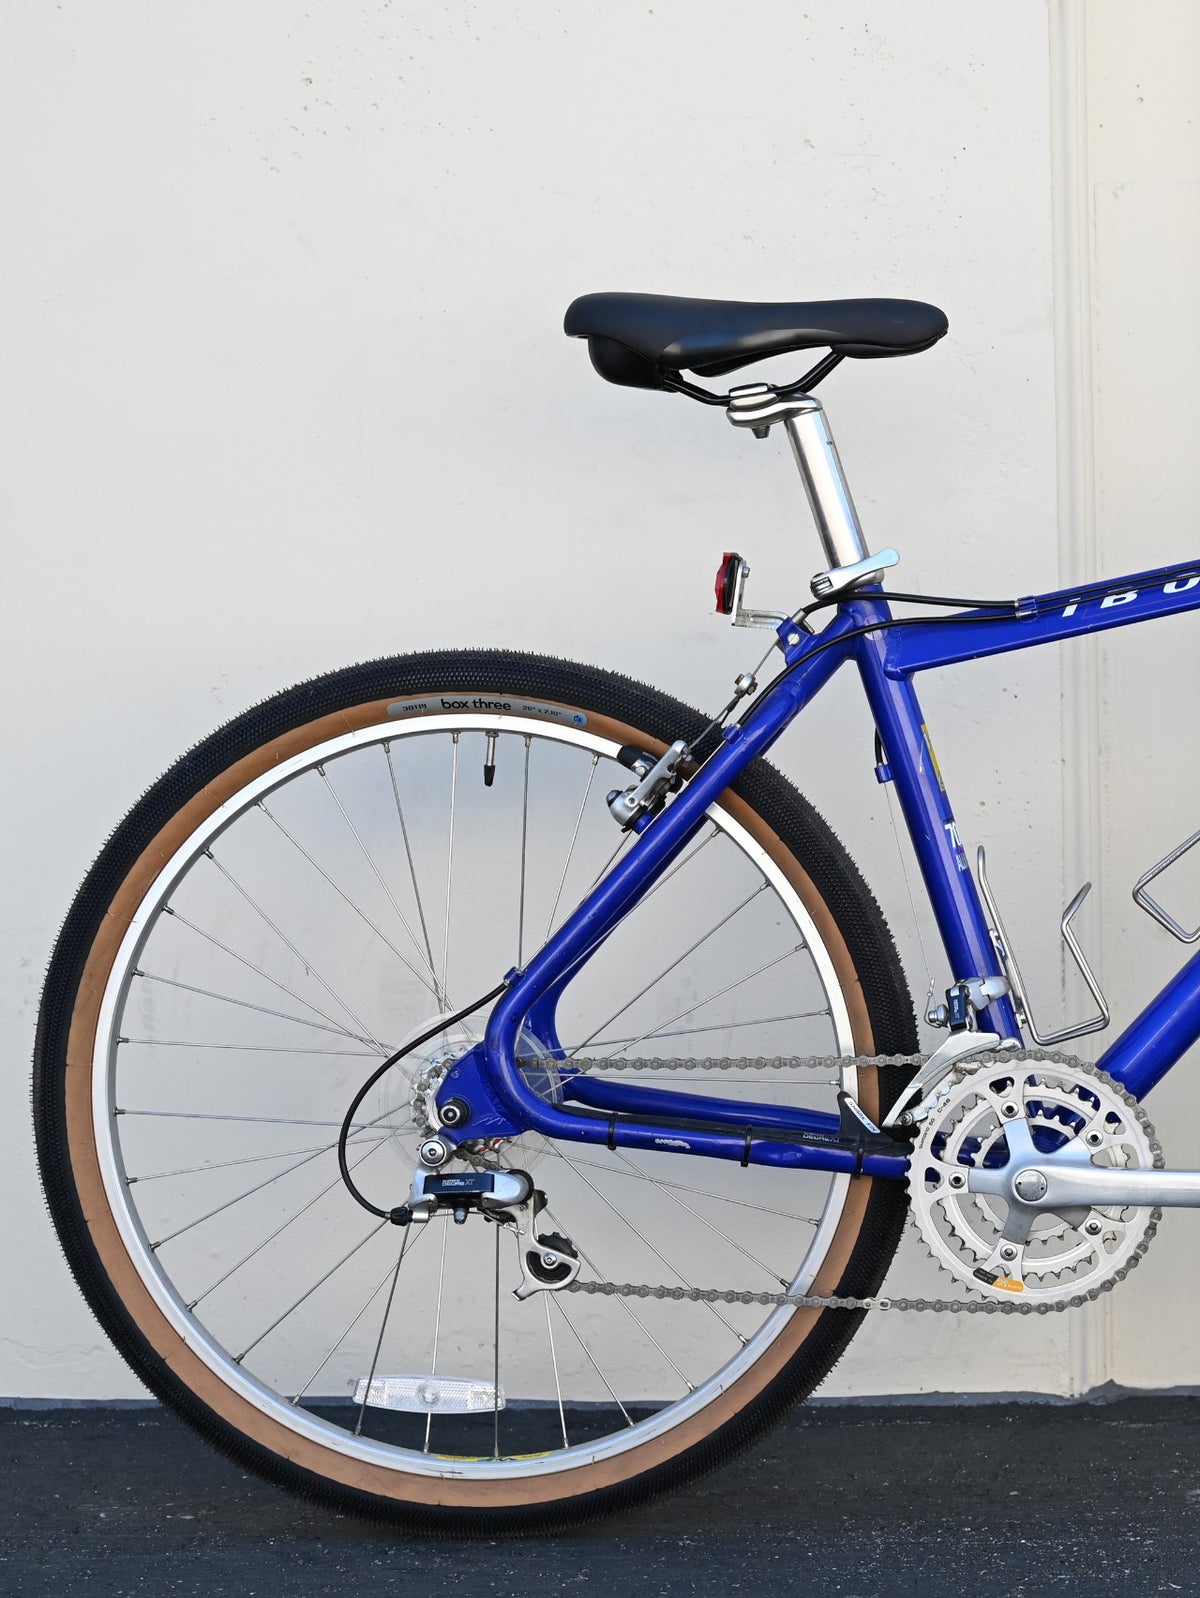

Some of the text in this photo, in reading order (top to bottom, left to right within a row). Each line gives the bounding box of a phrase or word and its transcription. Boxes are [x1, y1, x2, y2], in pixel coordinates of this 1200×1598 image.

[440, 698, 512, 711] box three
[465, 1178, 475, 1186] XT
